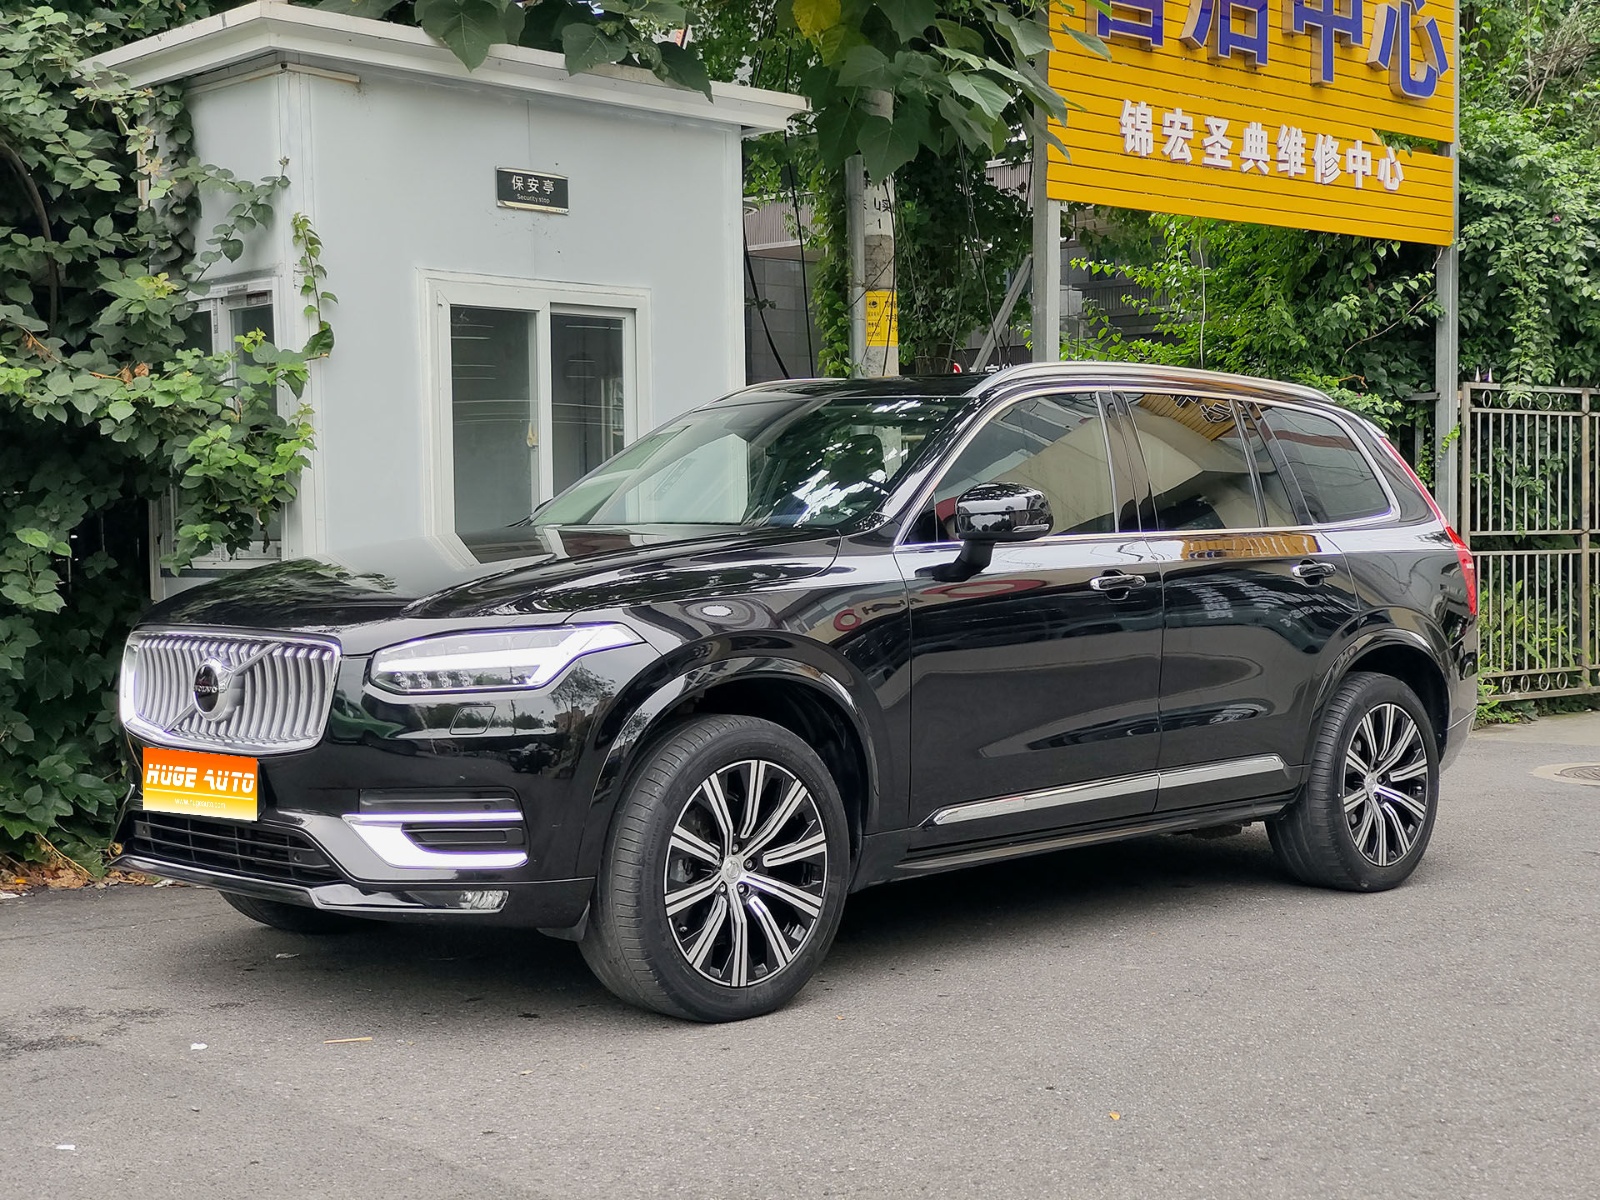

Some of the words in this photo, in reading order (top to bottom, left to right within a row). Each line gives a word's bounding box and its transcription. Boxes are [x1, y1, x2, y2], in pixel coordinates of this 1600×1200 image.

[1119, 99, 1405, 192] 锦宏圣典维修中心
[511, 174, 555, 195] 保安亭
[516, 193, 538, 203] Security
